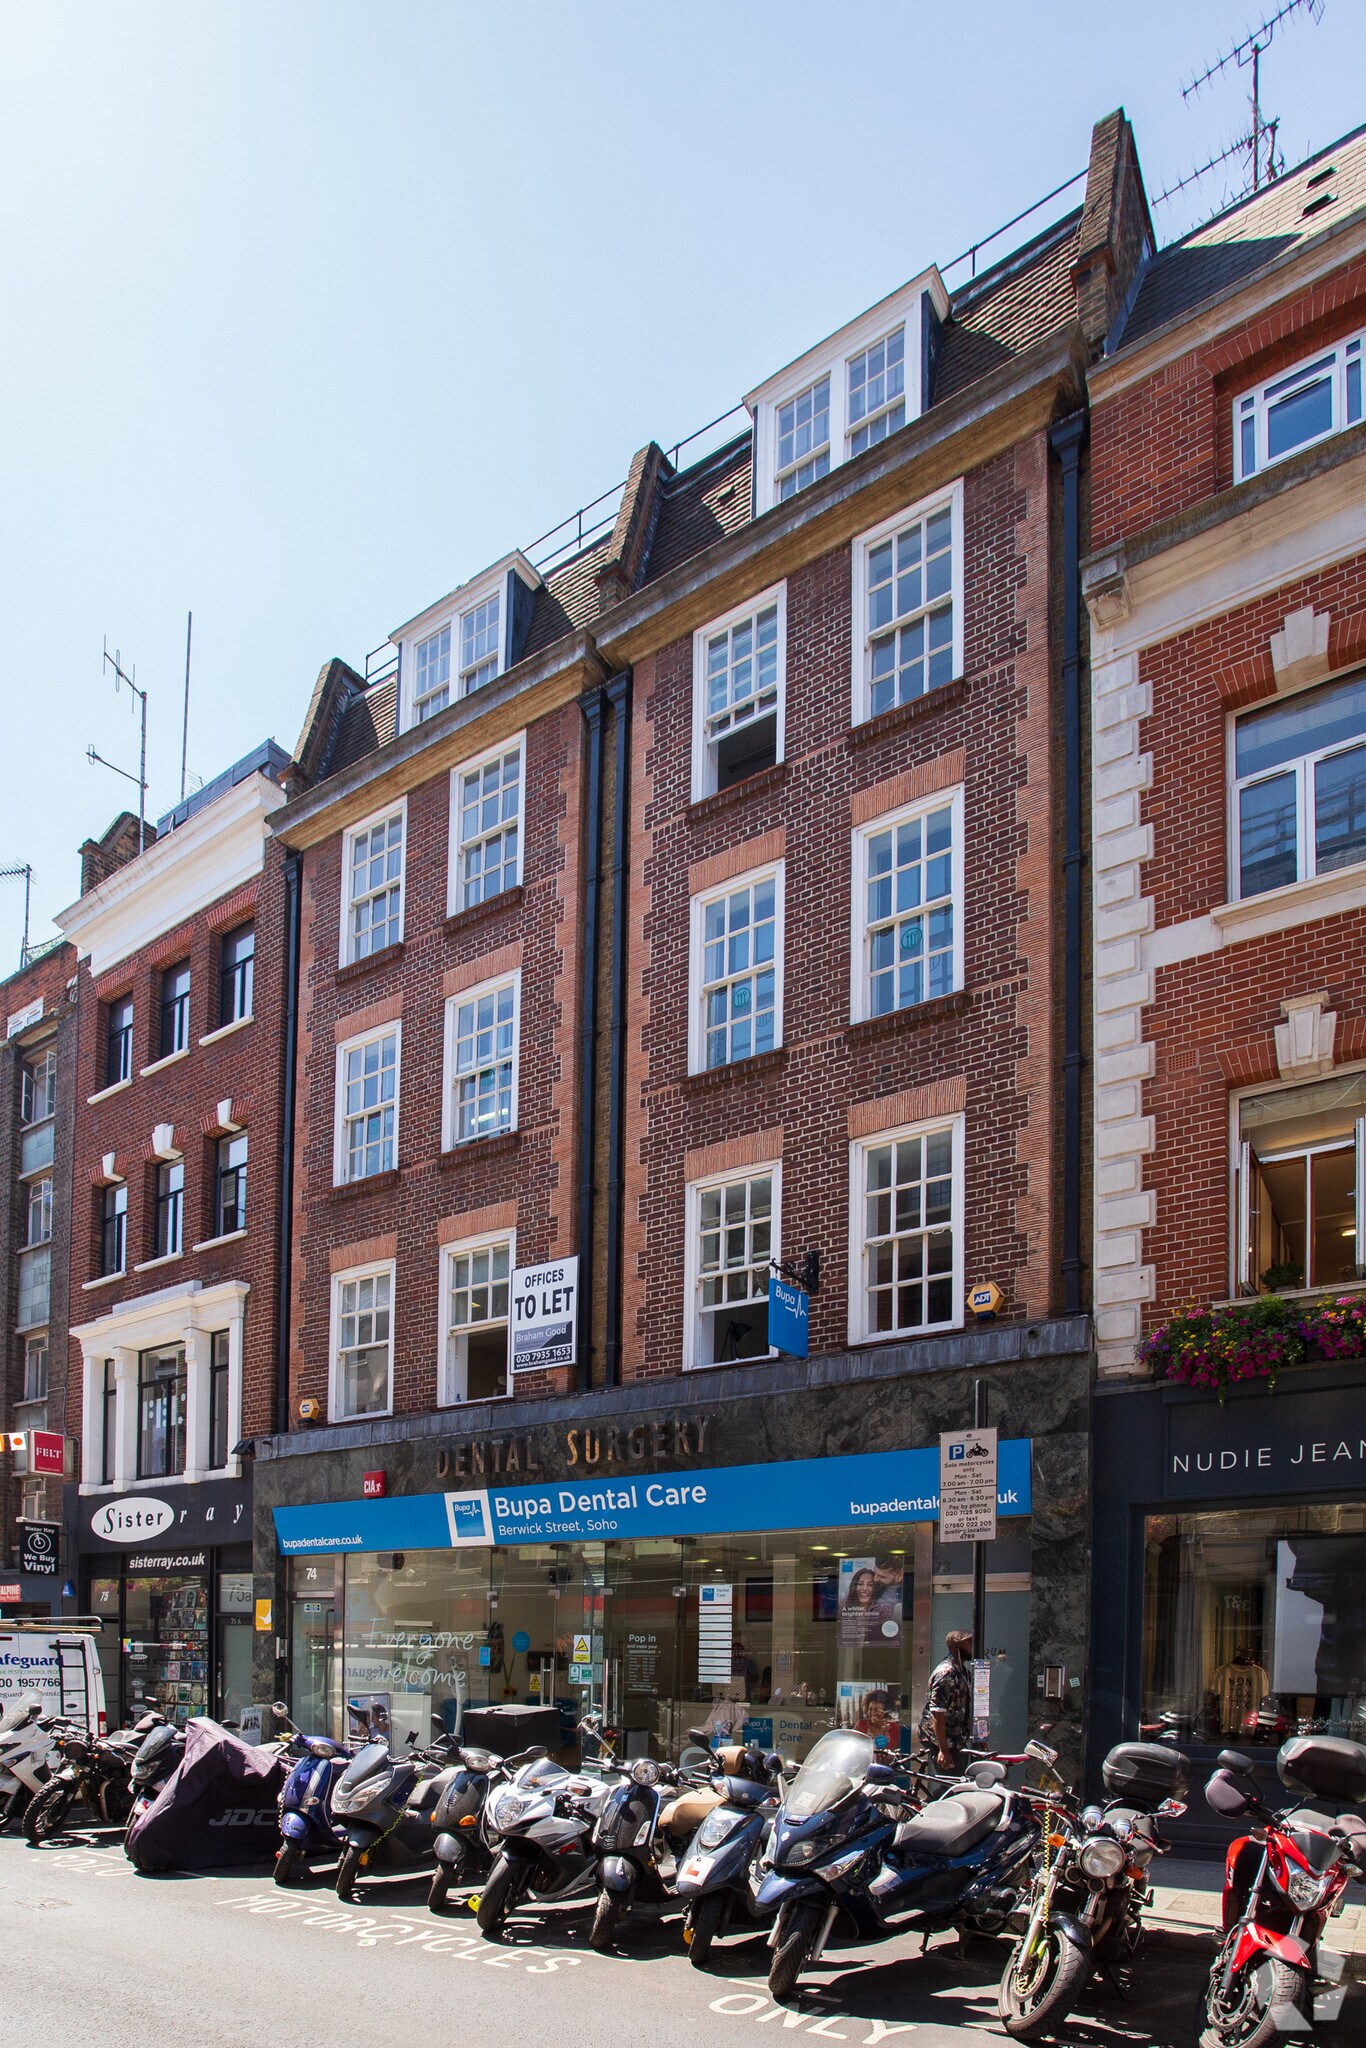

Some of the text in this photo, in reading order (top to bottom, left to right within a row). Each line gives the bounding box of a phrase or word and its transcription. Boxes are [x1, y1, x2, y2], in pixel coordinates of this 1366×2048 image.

[525, 1269, 564, 1288] OFFICES
[515, 1286, 574, 1320] TO LET
[775, 1285, 796, 1305] Bupa
[974, 1292, 991, 1304] ADT
[516, 1324, 567, 1342] Braham Good
[516, 1347, 571, 1363] 020 7935 1653
[36, 1447, 62, 1459] FELT
[436, 1415, 709, 1479] DENTAL SURGERY
[952, 1446, 963, 1459] P
[959, 1460, 994, 1468] motorcycles
[1173, 1447, 1272, 1473] NUDIE
[363, 1480, 375, 1494] CIA
[454, 1503, 470, 1513] Bupa
[494, 1484, 707, 1519] Bupa Dental Care
[103, 1507, 163, 1534] Sister
[498, 1518, 617, 1537] Berwick Street, Soho
[282, 1534, 363, 1549] bupadentalcare.co.uk
[23, 1553, 55, 1564] We Buy
[129, 1552, 206, 1570] sisterray.co.uk
[23, 1561, 55, 1574] Vinyl
[306, 1567, 317, 1580] 74
[100, 1591, 109, 1602] 75
[369, 1617, 474, 1665] Everyone
[629, 1634, 656, 1643] Pop in
[376, 1654, 466, 1688] welcome
[780, 1721, 812, 1730] Dental
[780, 1733, 803, 1742] Care
[208, 1808, 279, 1826] JDC
[30, 1854, 138, 1877] SOLO
[685, 1863, 700, 1877] L
[214, 1894, 582, 1974] MOTORCYCLES
[708, 1993, 918, 2045] ONLY
